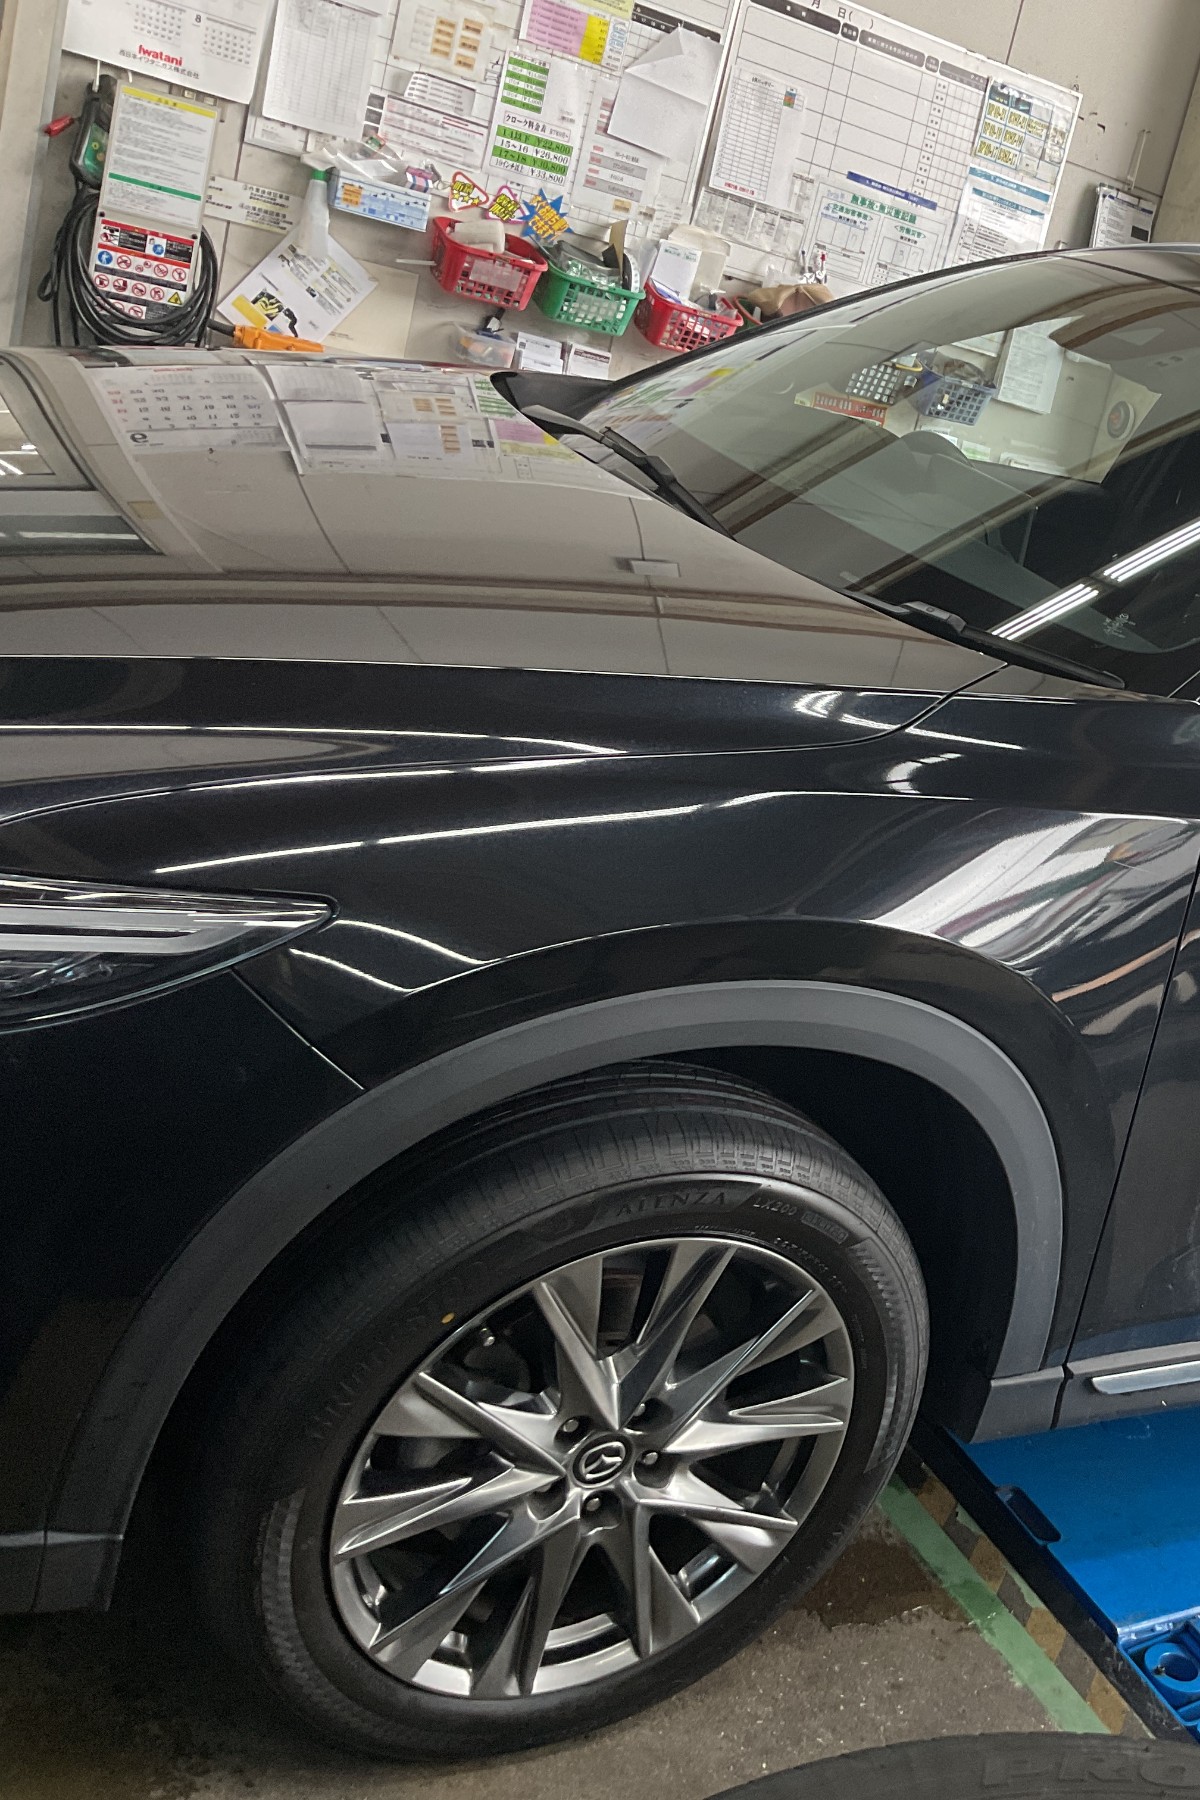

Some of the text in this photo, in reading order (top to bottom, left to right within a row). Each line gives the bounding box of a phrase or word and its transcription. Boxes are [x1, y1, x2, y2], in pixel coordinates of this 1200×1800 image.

[119, 49, 200, 79] 西日本イワタニガス株式会社
[138, 44, 183, 67] Iwatani
[505, 114, 546, 133] クローク料金表
[530, 168, 564, 184] ¥33,800
[617, 1191, 727, 1218] ALENZA
[752, 1196, 798, 1217] LX200
